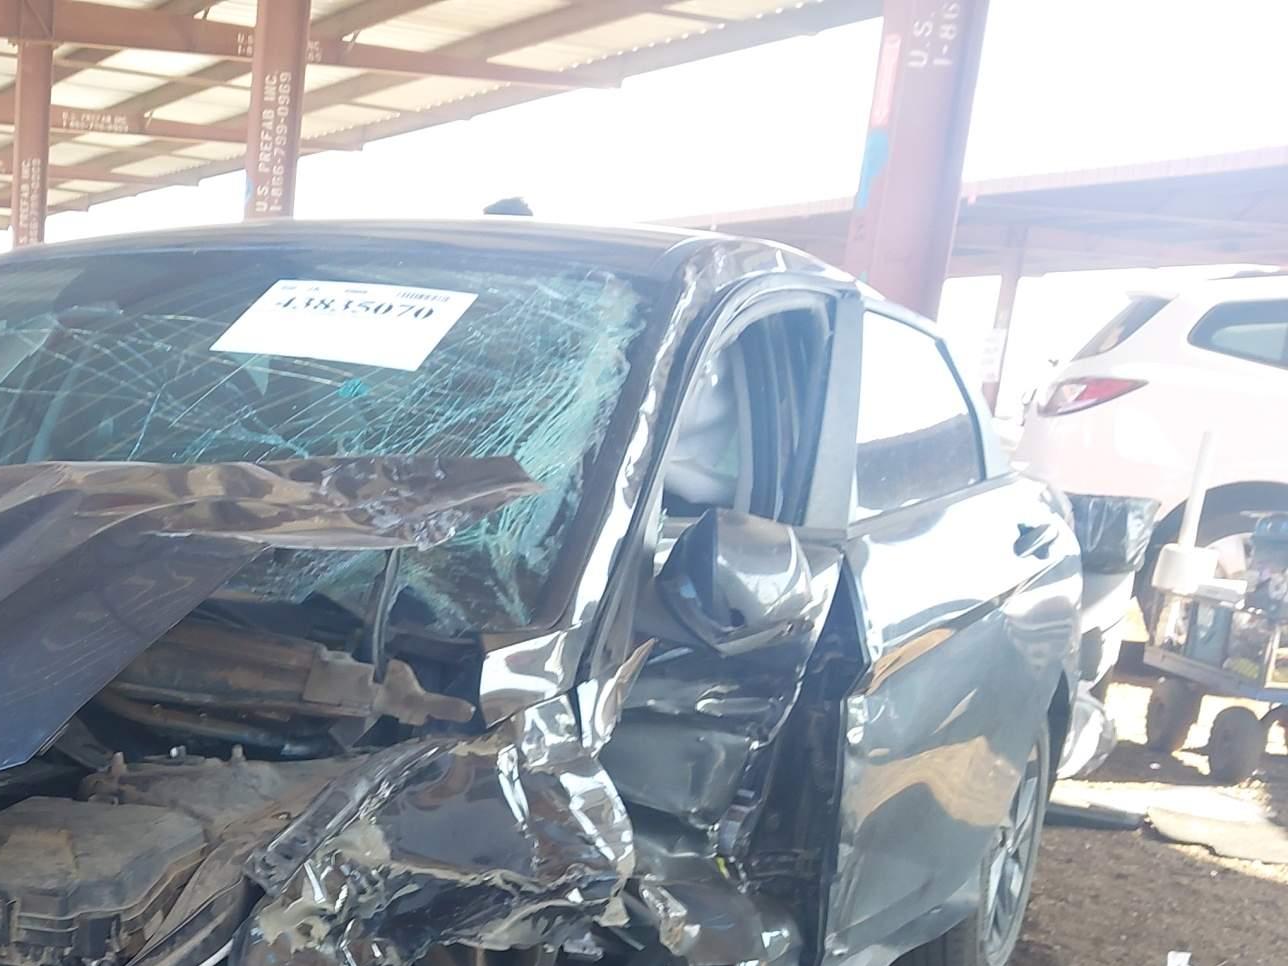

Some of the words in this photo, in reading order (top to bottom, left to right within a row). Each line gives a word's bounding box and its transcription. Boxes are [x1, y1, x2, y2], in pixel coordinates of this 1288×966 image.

[258, 109, 275, 173] PREFAB
[269, 71, 292, 213] 1-866-799-0969
[255, 181, 270, 213] U.S.
[274, 296, 435, 320] 43835070
